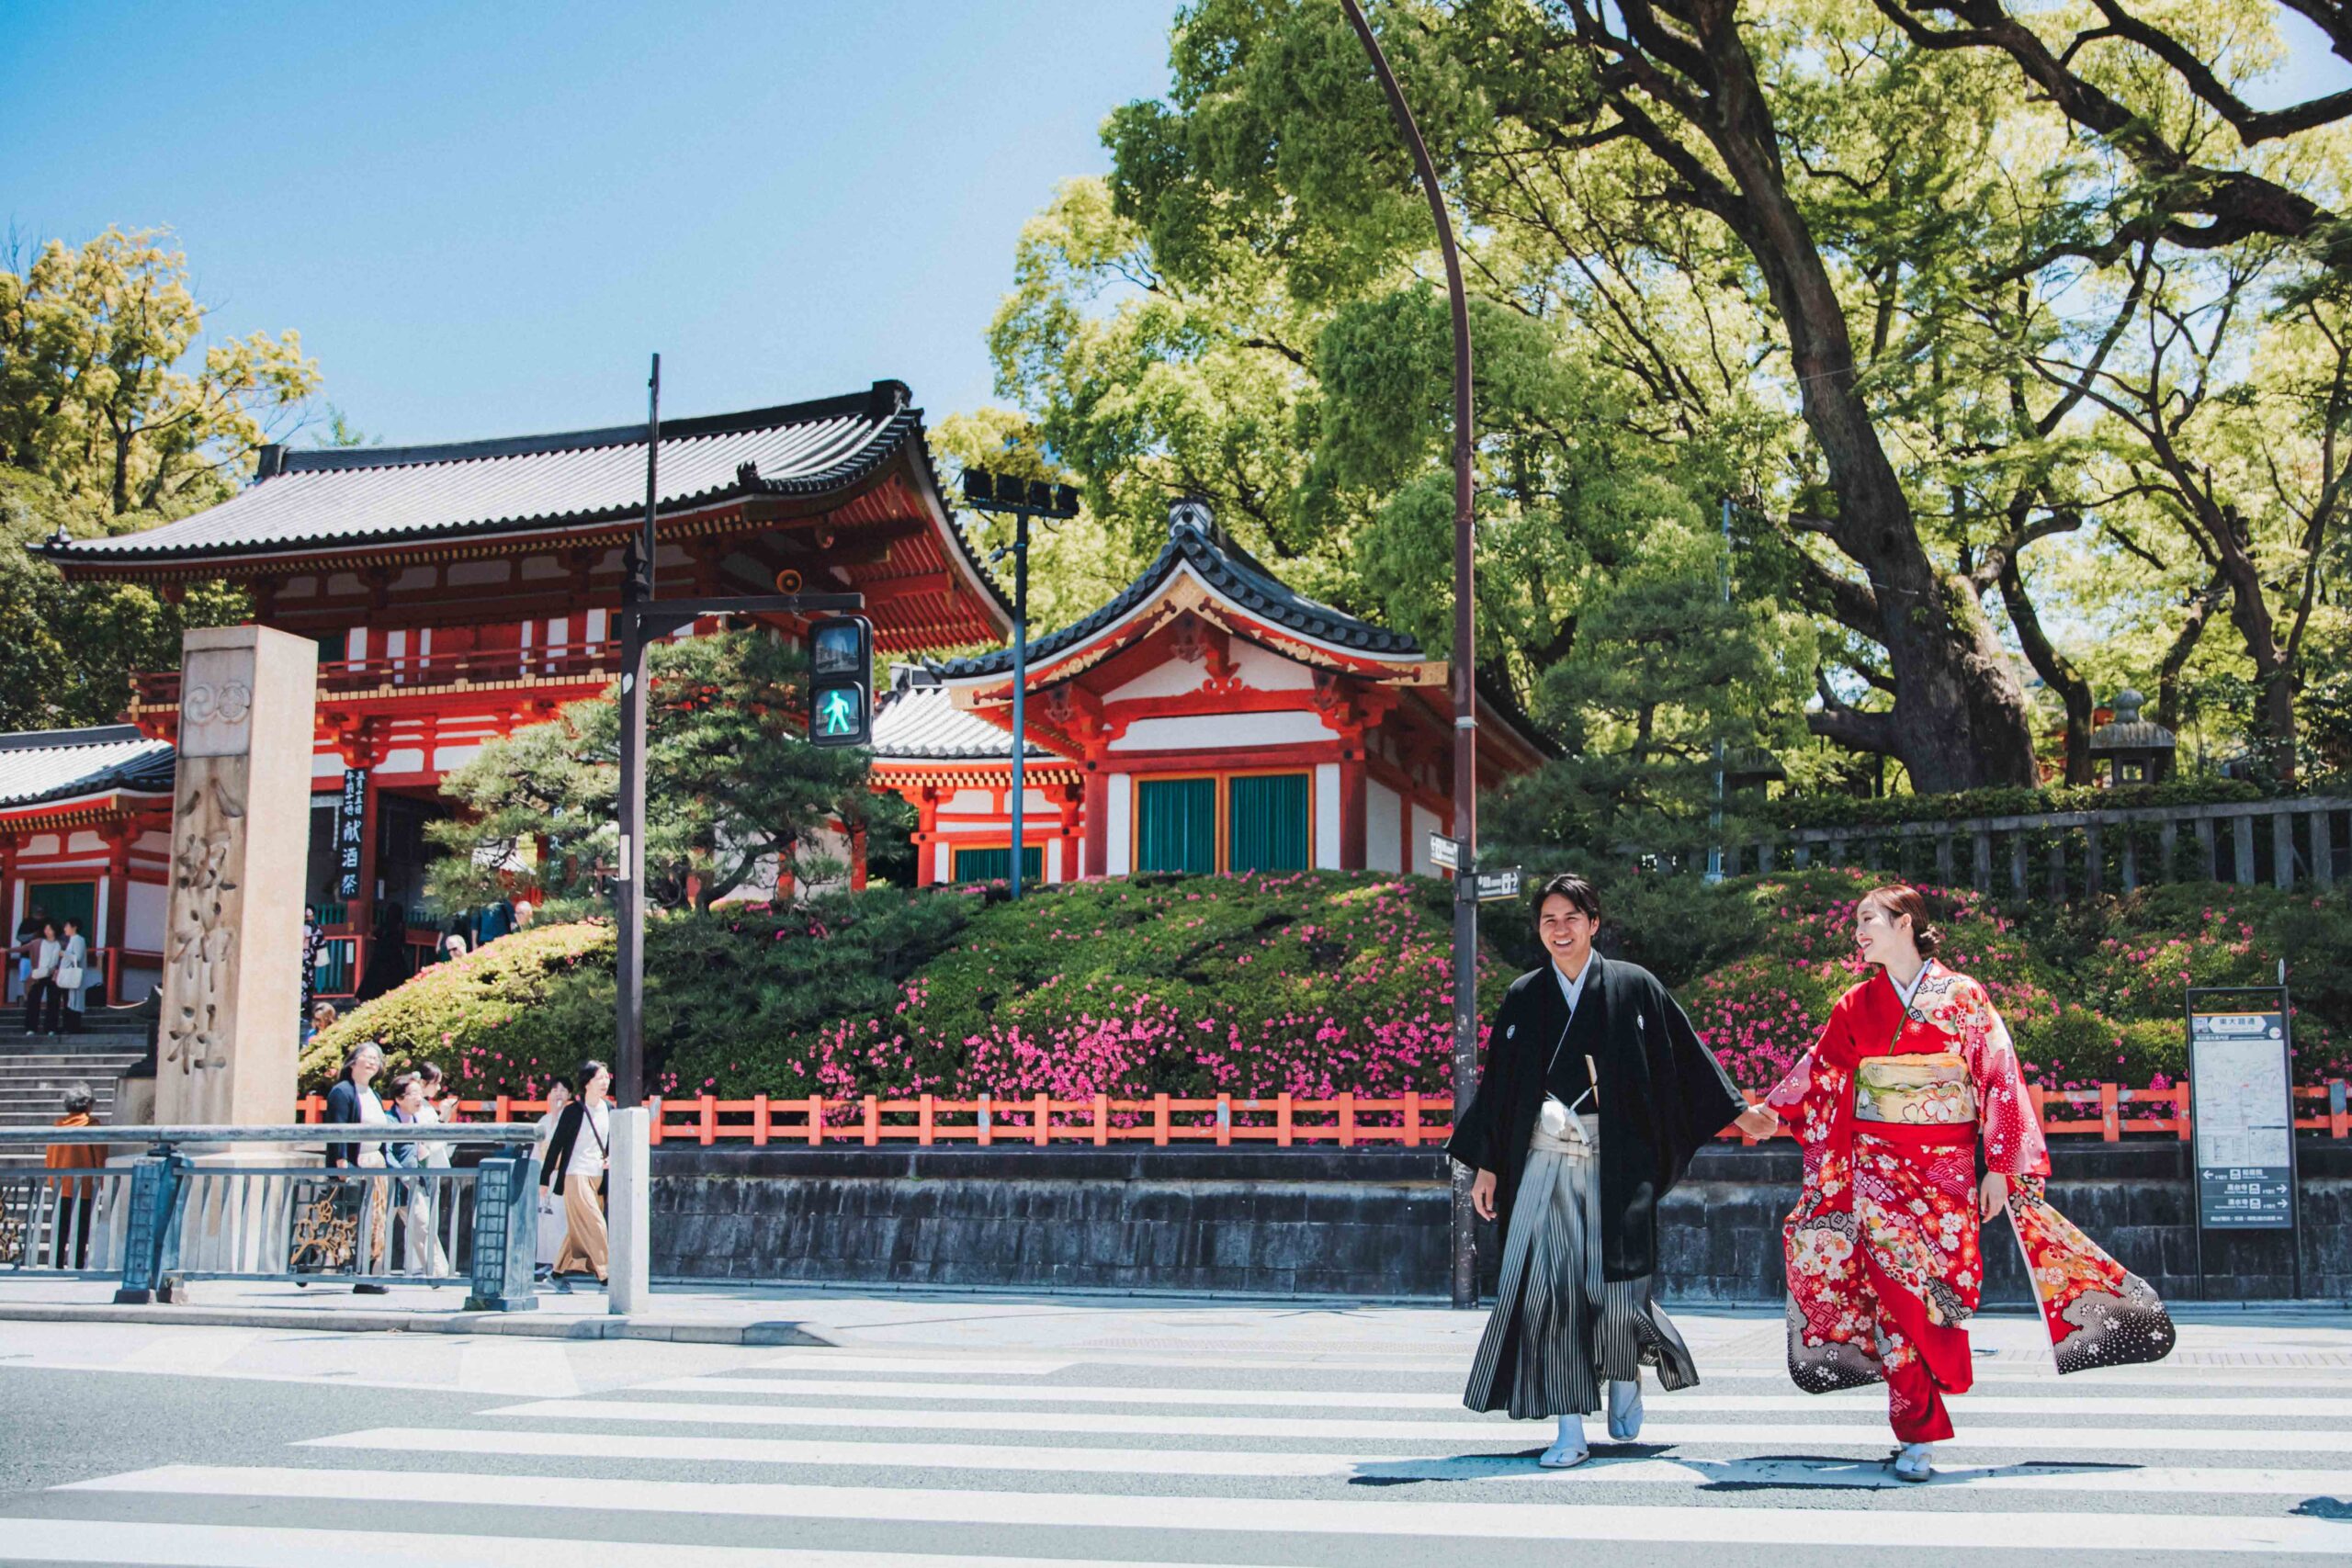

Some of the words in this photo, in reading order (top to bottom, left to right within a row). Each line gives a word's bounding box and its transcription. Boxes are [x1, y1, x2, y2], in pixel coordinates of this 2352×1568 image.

[167, 777, 244, 1076] 八坂神社
[342, 819, 362, 896] 献酒祭
